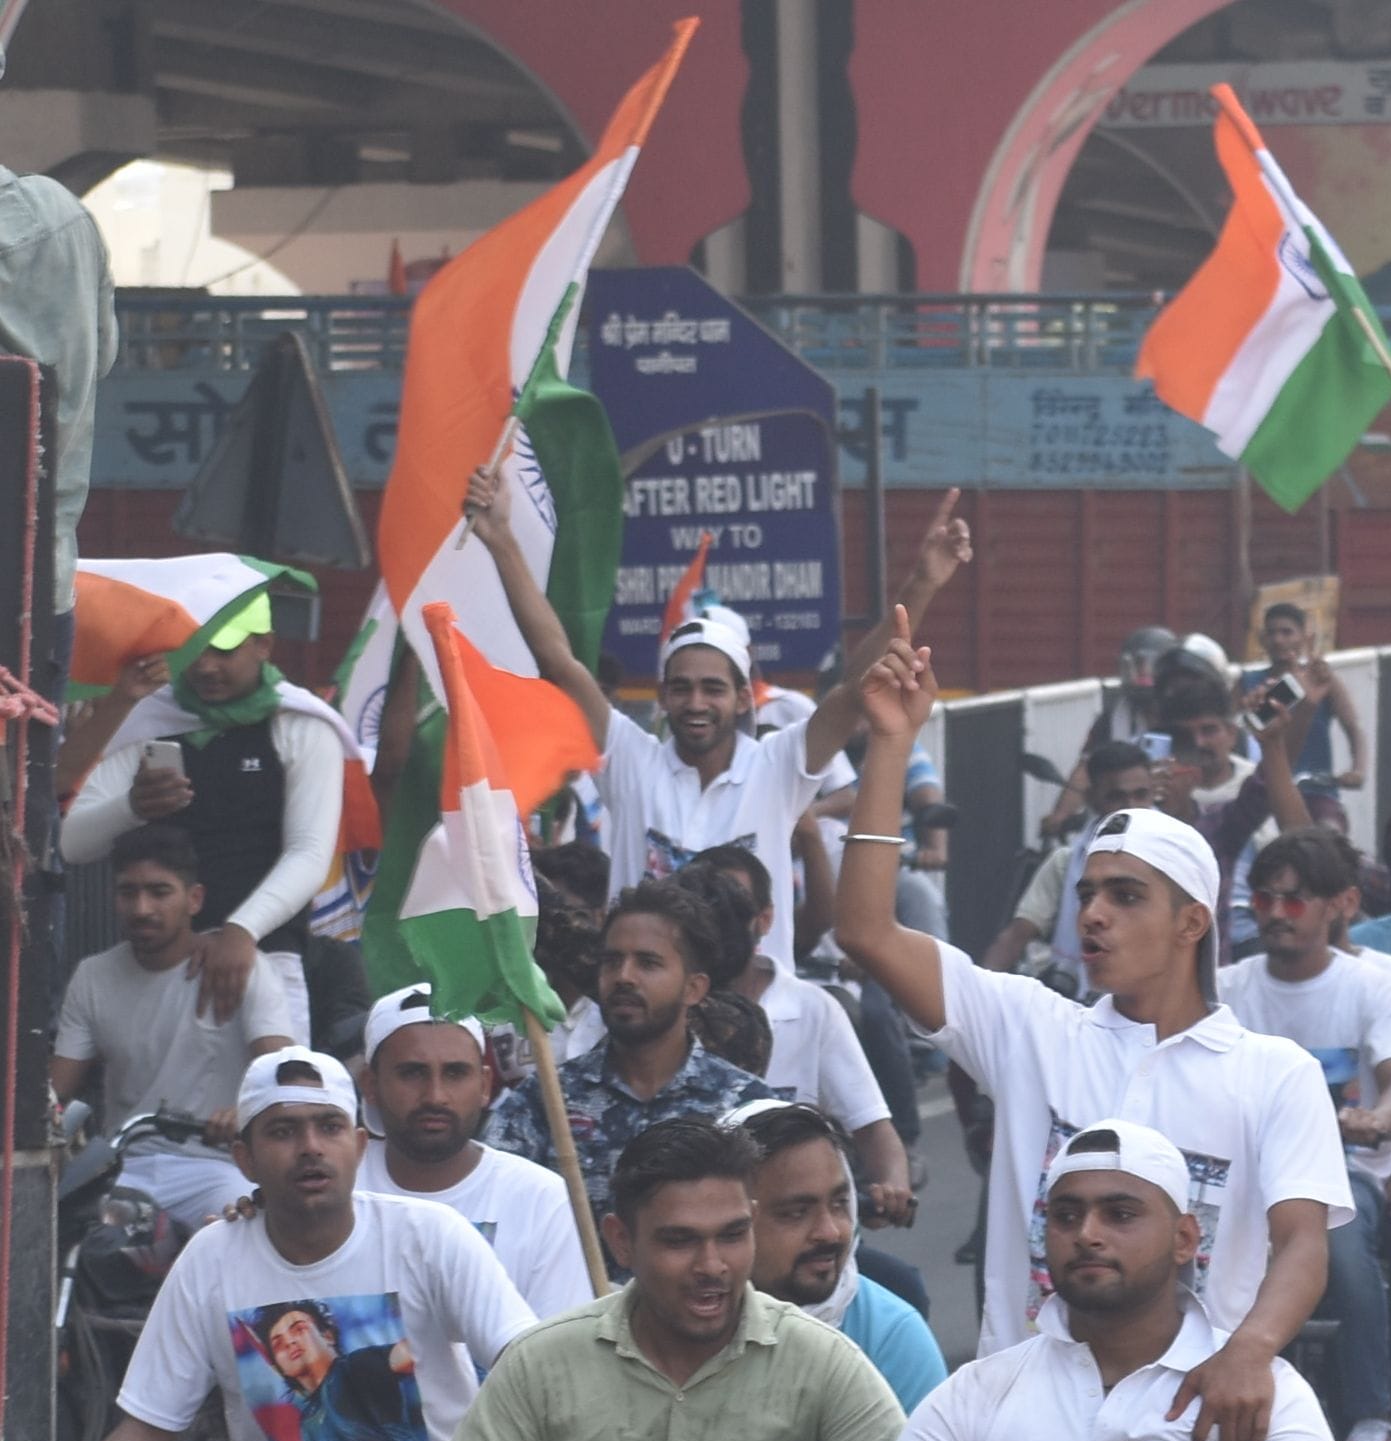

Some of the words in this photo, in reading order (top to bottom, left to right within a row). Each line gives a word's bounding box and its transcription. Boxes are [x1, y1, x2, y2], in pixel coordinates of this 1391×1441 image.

[701, 424, 762, 463] TURN
[694, 475, 742, 514] RED
[747, 472, 817, 511] LIGHT
[729, 525, 763, 548] TO
[615, 567, 654, 605] SHRI
[773, 561, 824, 599] DHAM
